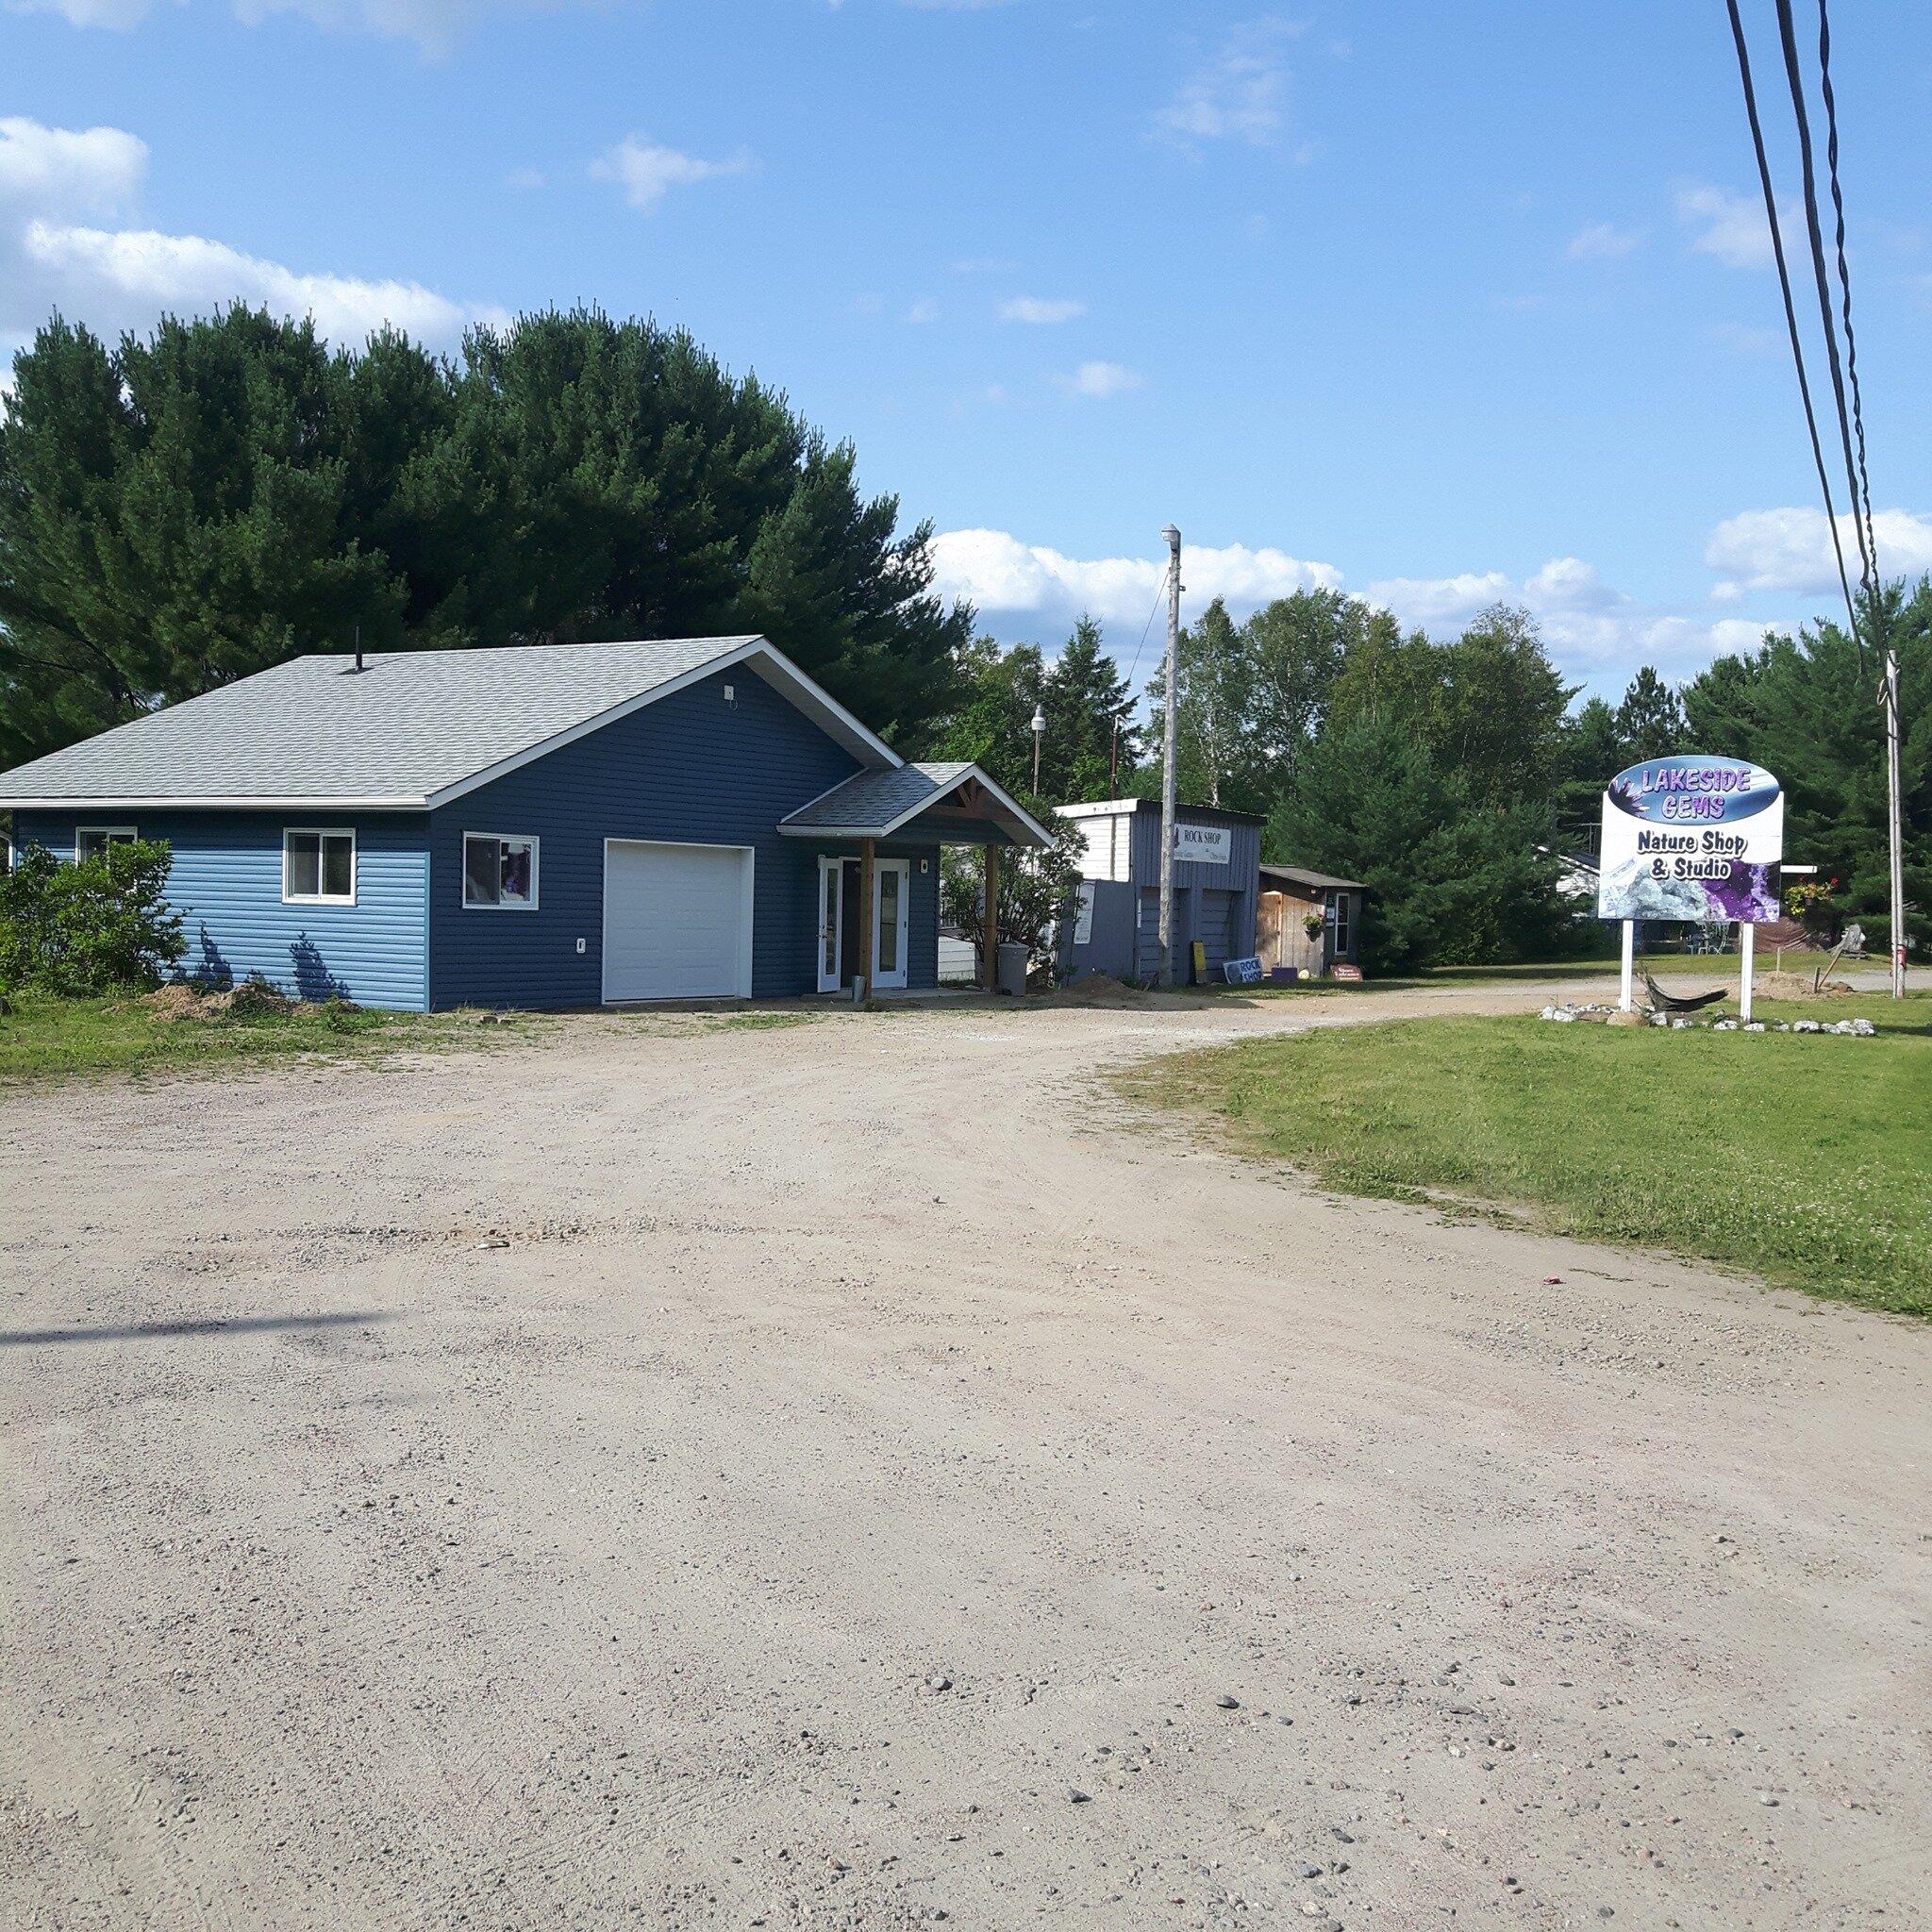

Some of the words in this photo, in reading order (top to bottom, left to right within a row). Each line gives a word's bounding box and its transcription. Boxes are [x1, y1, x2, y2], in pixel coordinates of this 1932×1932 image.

[1641, 768, 1751, 792] LAKESIDE
[1662, 795, 1725, 818] GEMS
[1184, 830, 1203, 843] ROCK
[1204, 831, 1222, 845] SHOP
[1638, 830, 1696, 852] Nature
[1702, 830, 1746, 854] Shop
[1651, 858, 1668, 878] &
[1674, 858, 1731, 879] Studio
[1241, 959, 1260, 973] ROCK
